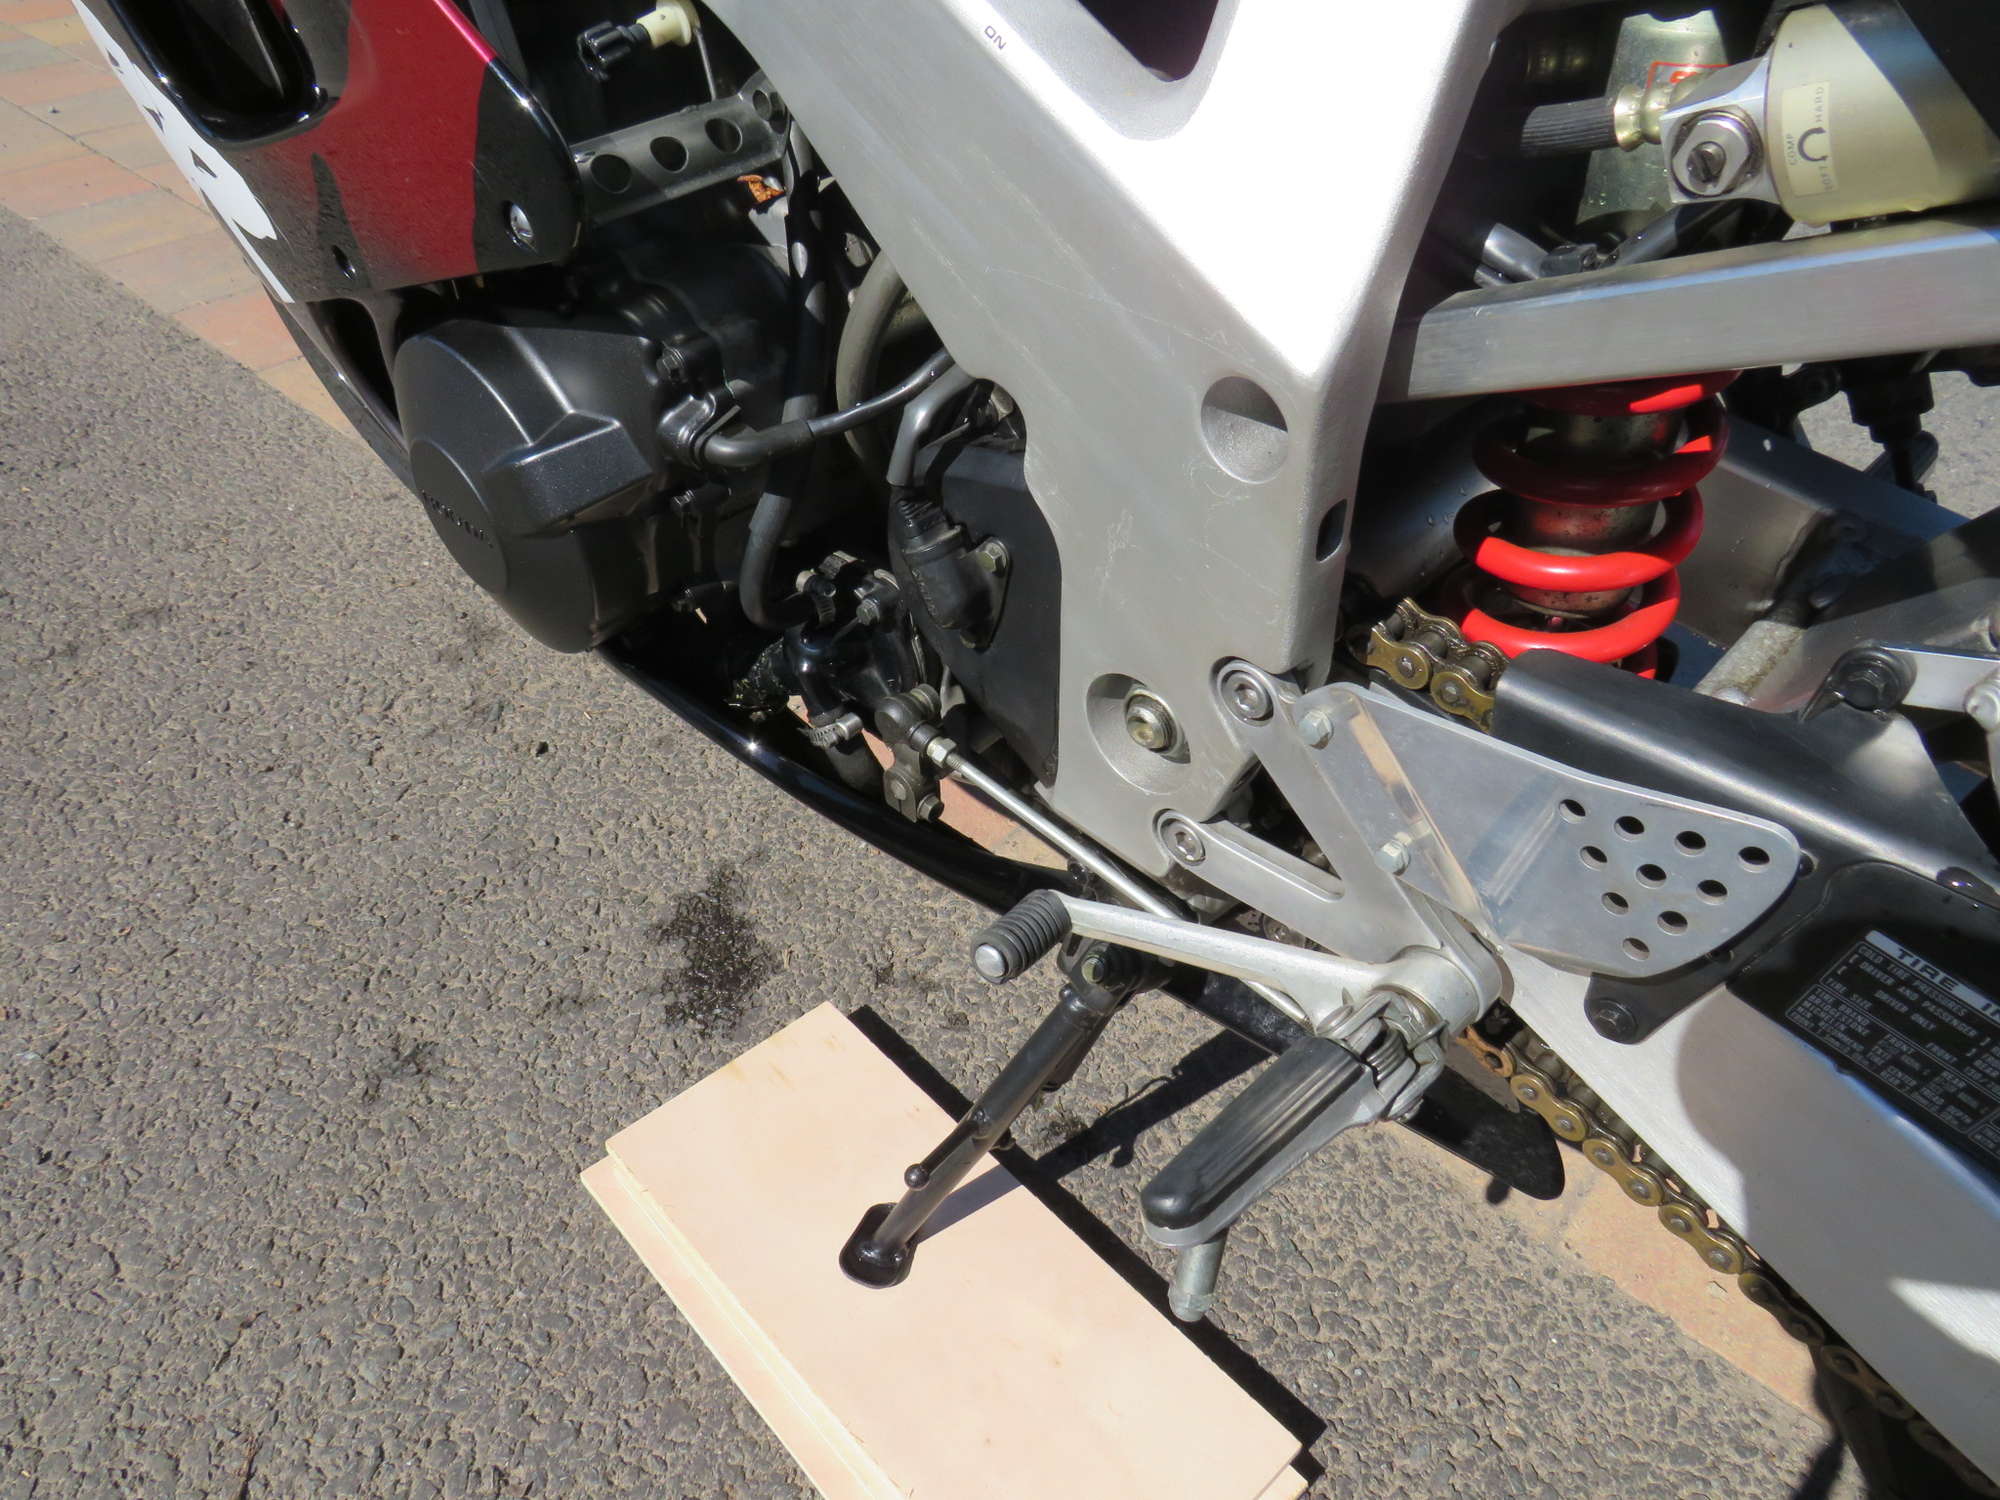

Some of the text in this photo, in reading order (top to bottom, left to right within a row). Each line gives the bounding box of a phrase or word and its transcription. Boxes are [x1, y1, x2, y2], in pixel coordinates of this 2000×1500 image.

[983, 25, 1008, 50] ON
[1815, 86, 1823, 122] HARD
[1786, 133, 1798, 166] COMP
[1857, 946, 1967, 1015] COLD TIRE PRESSURES
[1893, 949, 1958, 990] TIRE
[1814, 989, 1869, 1024] TIRE BRAND
[1825, 978, 1846, 992] TIRE
[1849, 993, 1872, 1009] SIZE
[1859, 962, 1895, 985] DRIVER
[1897, 985, 1919, 1000] AND
[1920, 1001, 1977, 1036] PASSENGER
[1874, 990, 1908, 1012] DRIVER
[1910, 1013, 1935, 1029] ONLY
[1801, 1001, 1846, 1030] MICHELIN
[1806, 995, 1870, 1035] BRIDGESTONE
[1884, 1034, 1914, 1054] FRONT
[1940, 1071, 1966, 1087] REAR
